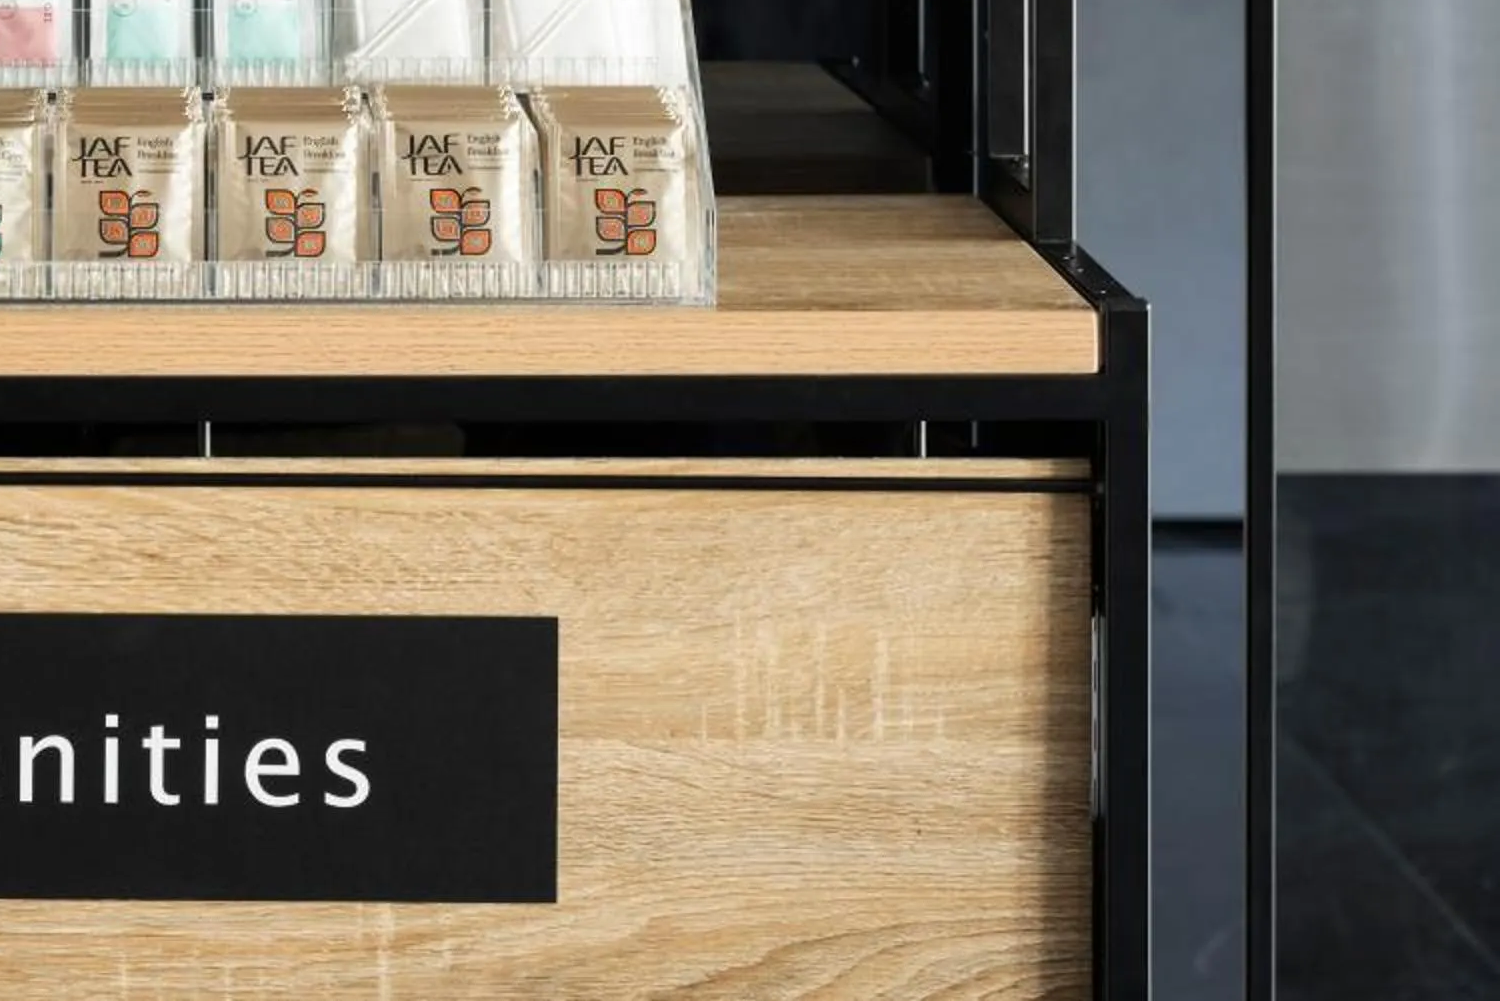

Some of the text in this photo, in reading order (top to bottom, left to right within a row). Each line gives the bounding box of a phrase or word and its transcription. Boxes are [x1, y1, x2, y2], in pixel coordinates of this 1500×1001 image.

[72, 136, 131, 160] JAF
[238, 135, 297, 159] JAF
[401, 133, 459, 159] JAF
[569, 136, 627, 159] JAF
[80, 157, 132, 178] TEA
[245, 156, 298, 178] TEA
[408, 155, 463, 176] TEA
[574, 156, 629, 176] TEA
